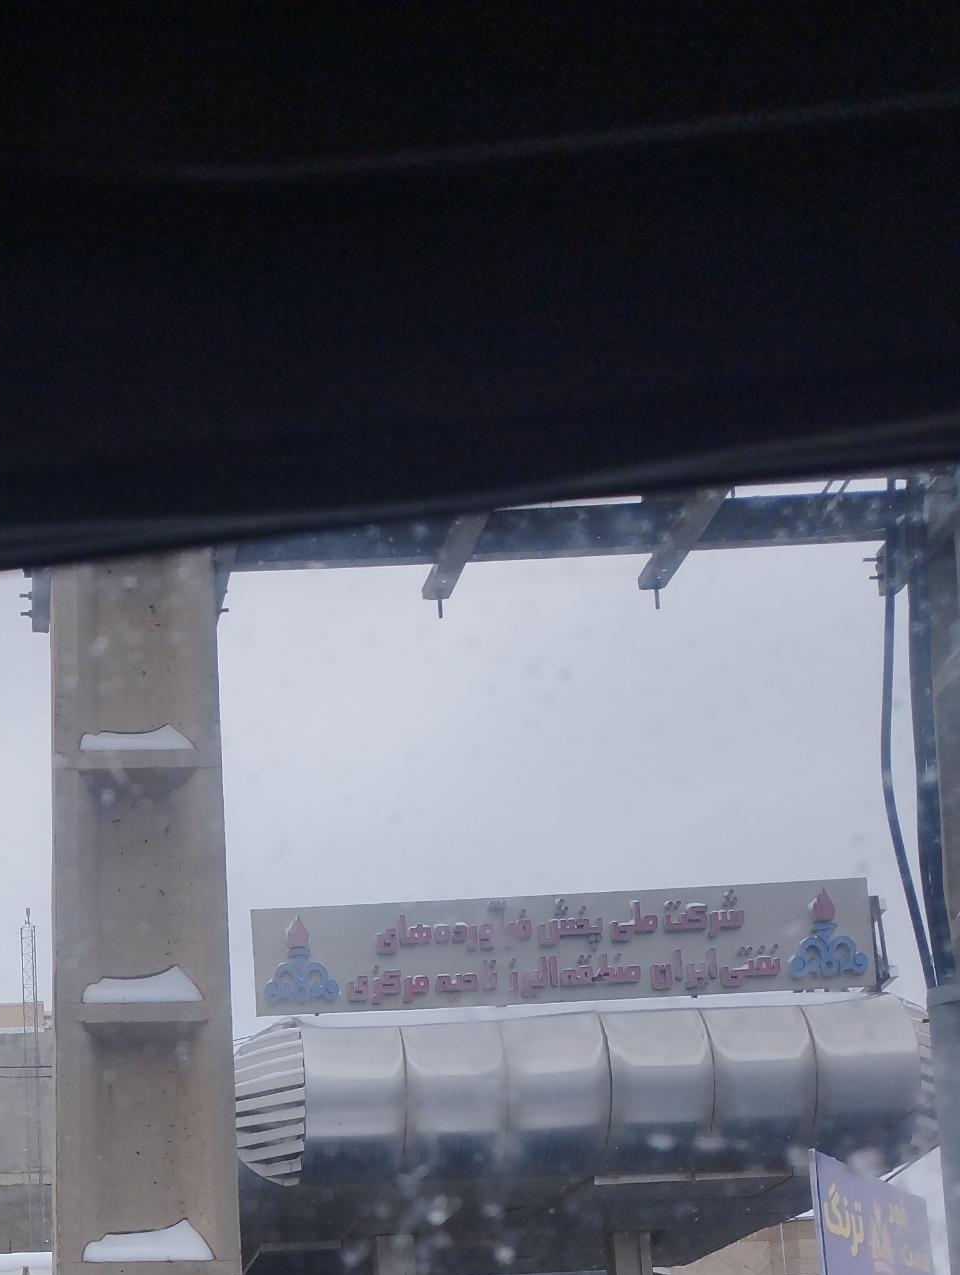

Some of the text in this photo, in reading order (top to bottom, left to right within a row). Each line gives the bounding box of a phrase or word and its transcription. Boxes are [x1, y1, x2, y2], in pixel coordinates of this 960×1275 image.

[538, 898, 604, 949] پخش
[609, 900, 659, 944] ملی
[663, 889, 746, 940] شرکت
[346, 964, 431, 1006] مرکزی
[507, 953, 559, 999] البرز
[558, 951, 641, 987] منطقه
[650, 948, 718, 991] ایران
[719, 944, 782, 989] نفتی
